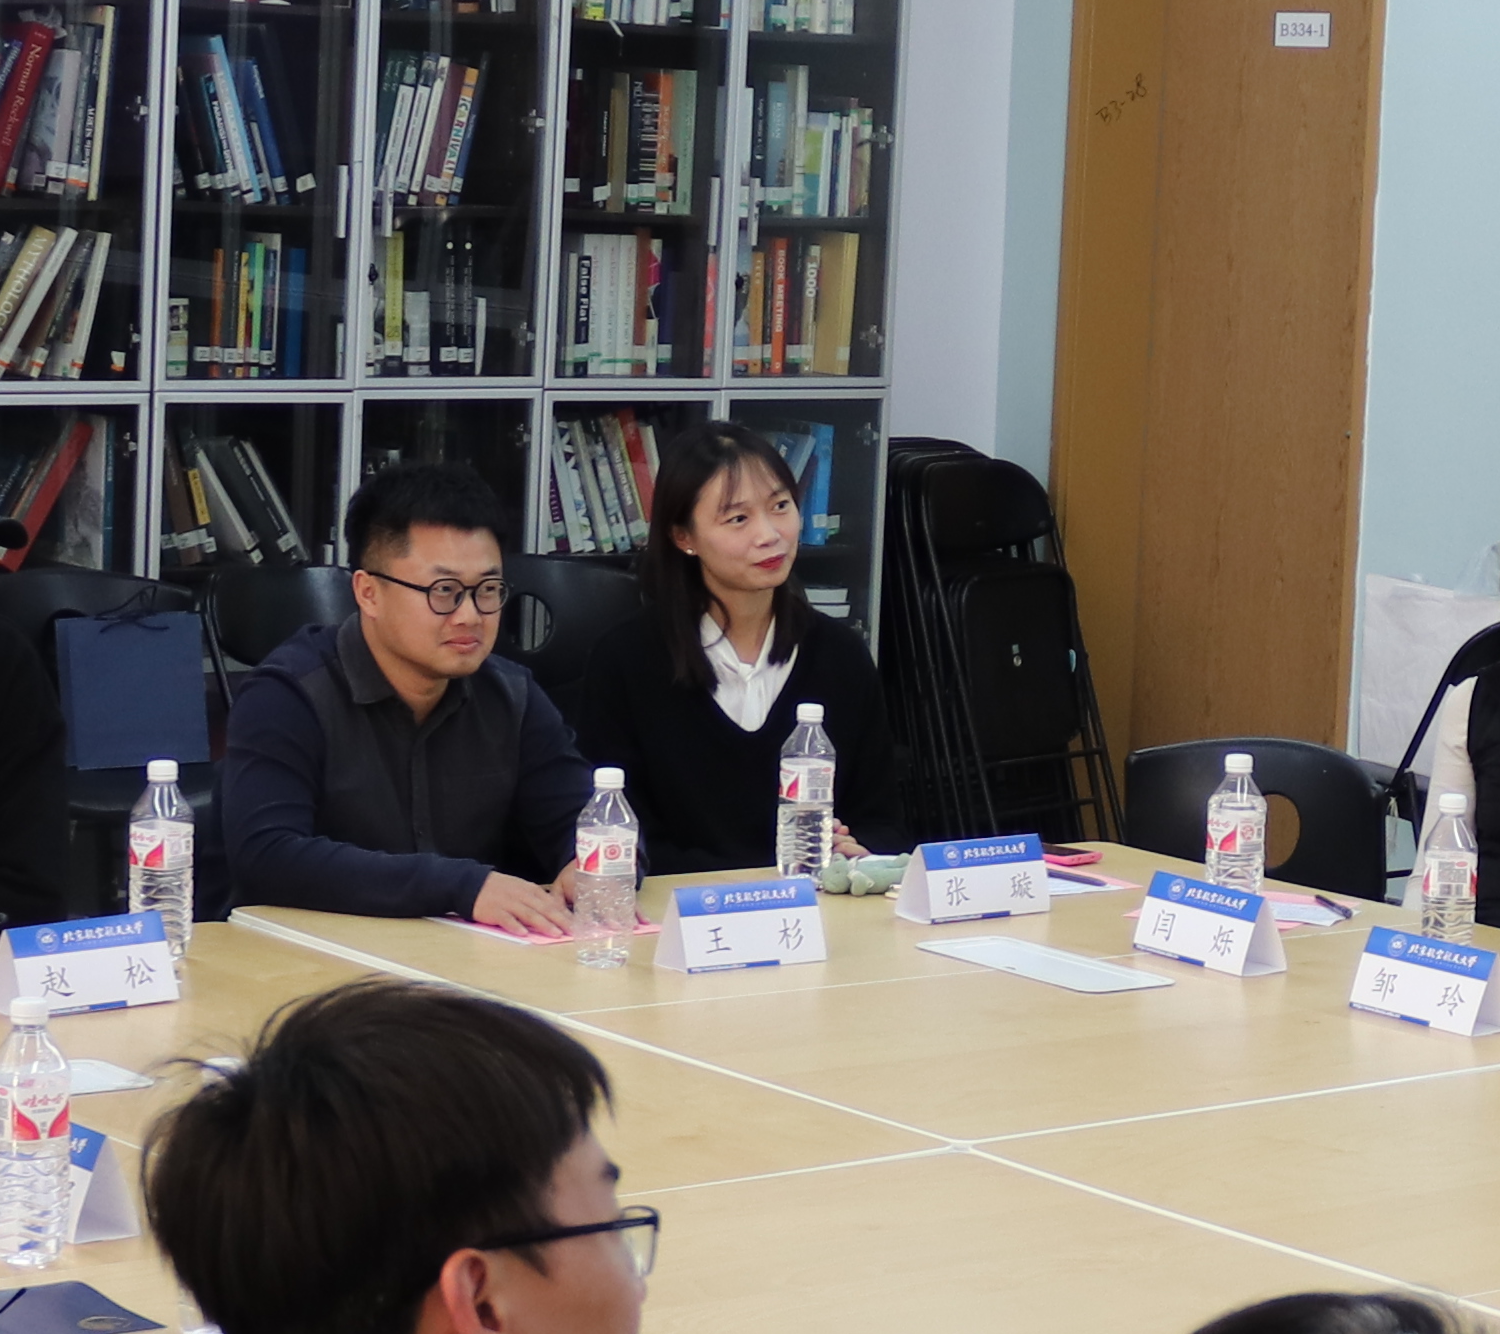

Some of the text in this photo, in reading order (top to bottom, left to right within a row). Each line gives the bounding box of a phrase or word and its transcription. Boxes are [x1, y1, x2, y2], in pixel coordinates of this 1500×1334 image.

[1279, 22, 1325, 38] B334-1
[2, 43, 43, 146] Norman Rockwell
[774, 249, 786, 333] BOOK MEETING
[805, 261, 818, 298] 1000
[706, 917, 805, 954] 王杉
[40, 955, 156, 998] 赵松
[1372, 967, 1466, 1017] 邹玲
